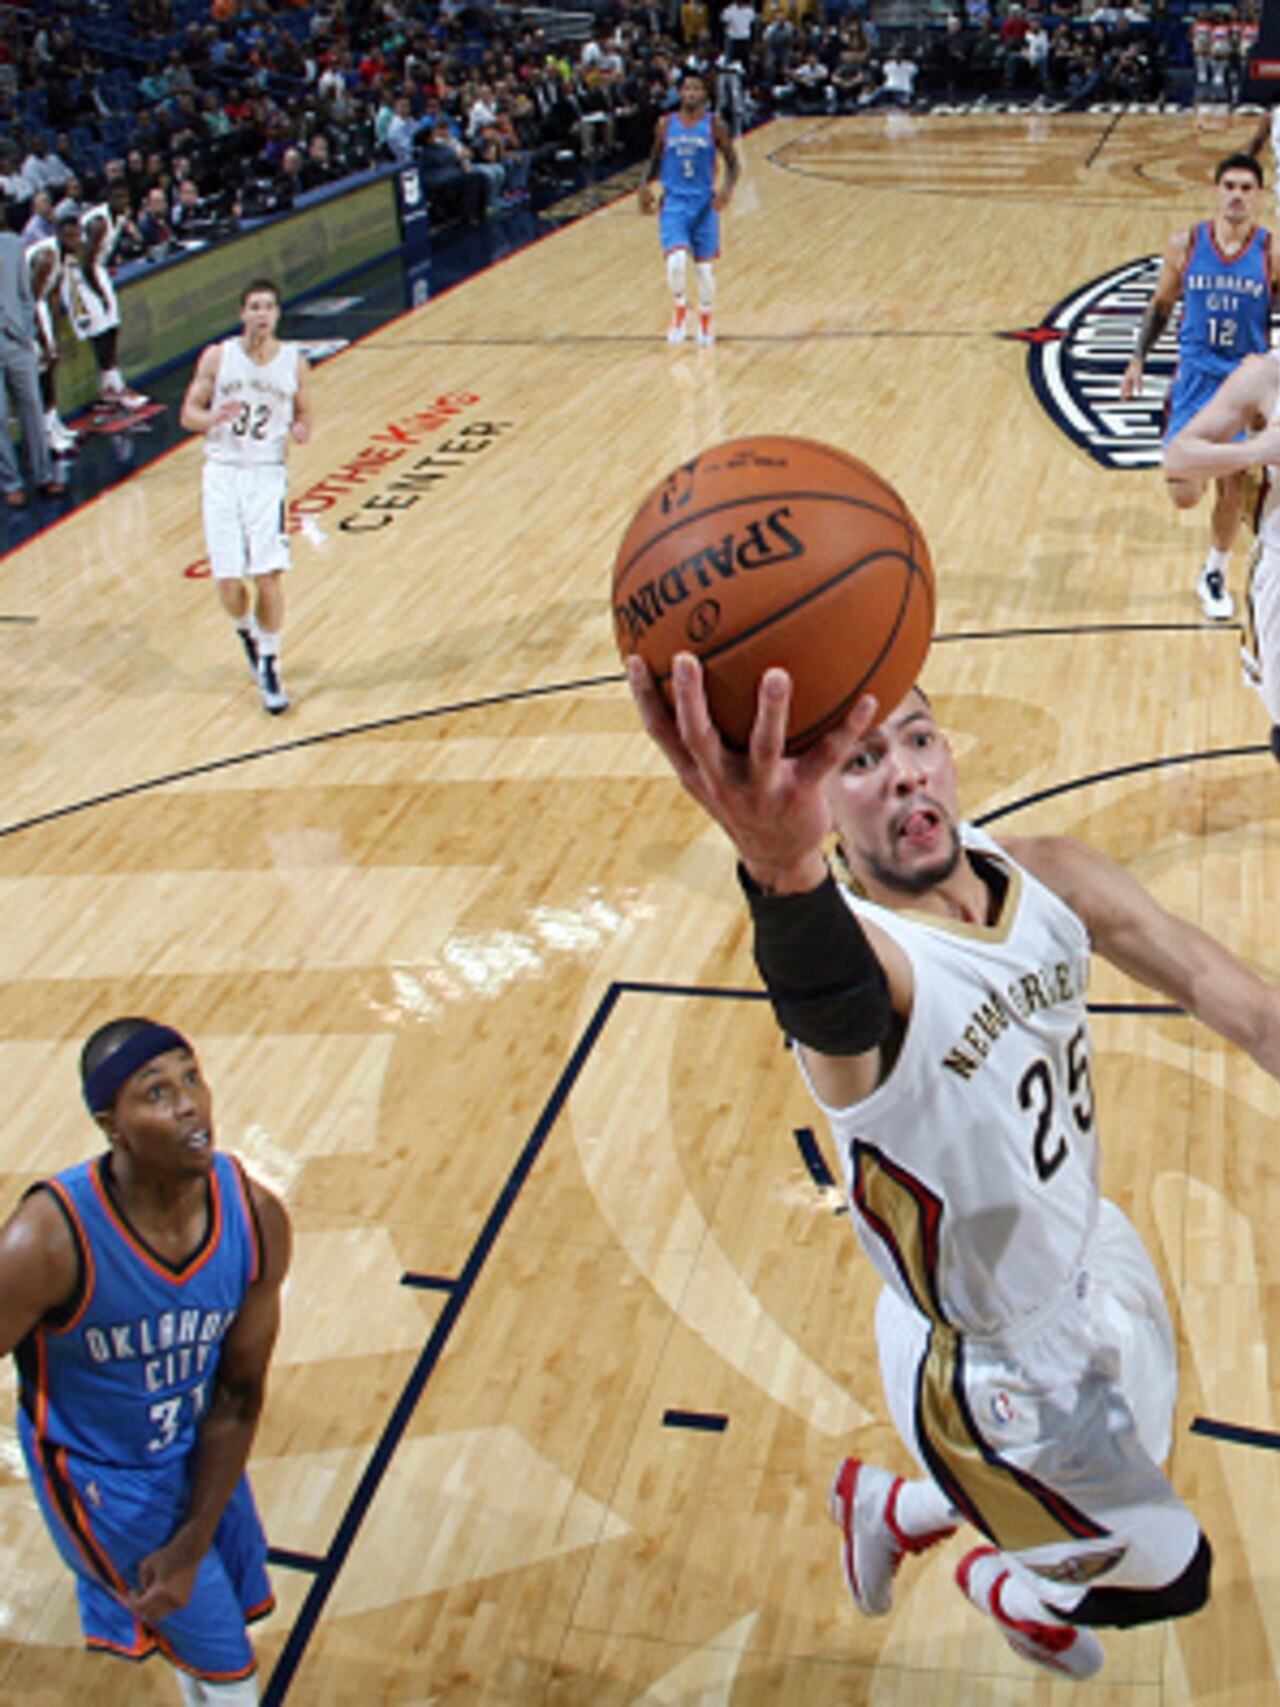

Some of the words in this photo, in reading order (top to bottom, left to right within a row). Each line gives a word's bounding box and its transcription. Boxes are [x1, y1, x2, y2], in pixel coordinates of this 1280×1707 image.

[1208, 318, 1239, 346] 12
[231, 401, 273, 440] 32
[338, 421, 513, 533] CENTER
[942, 989, 1010, 1081] NEW
[1018, 1026, 1093, 1182] 25
